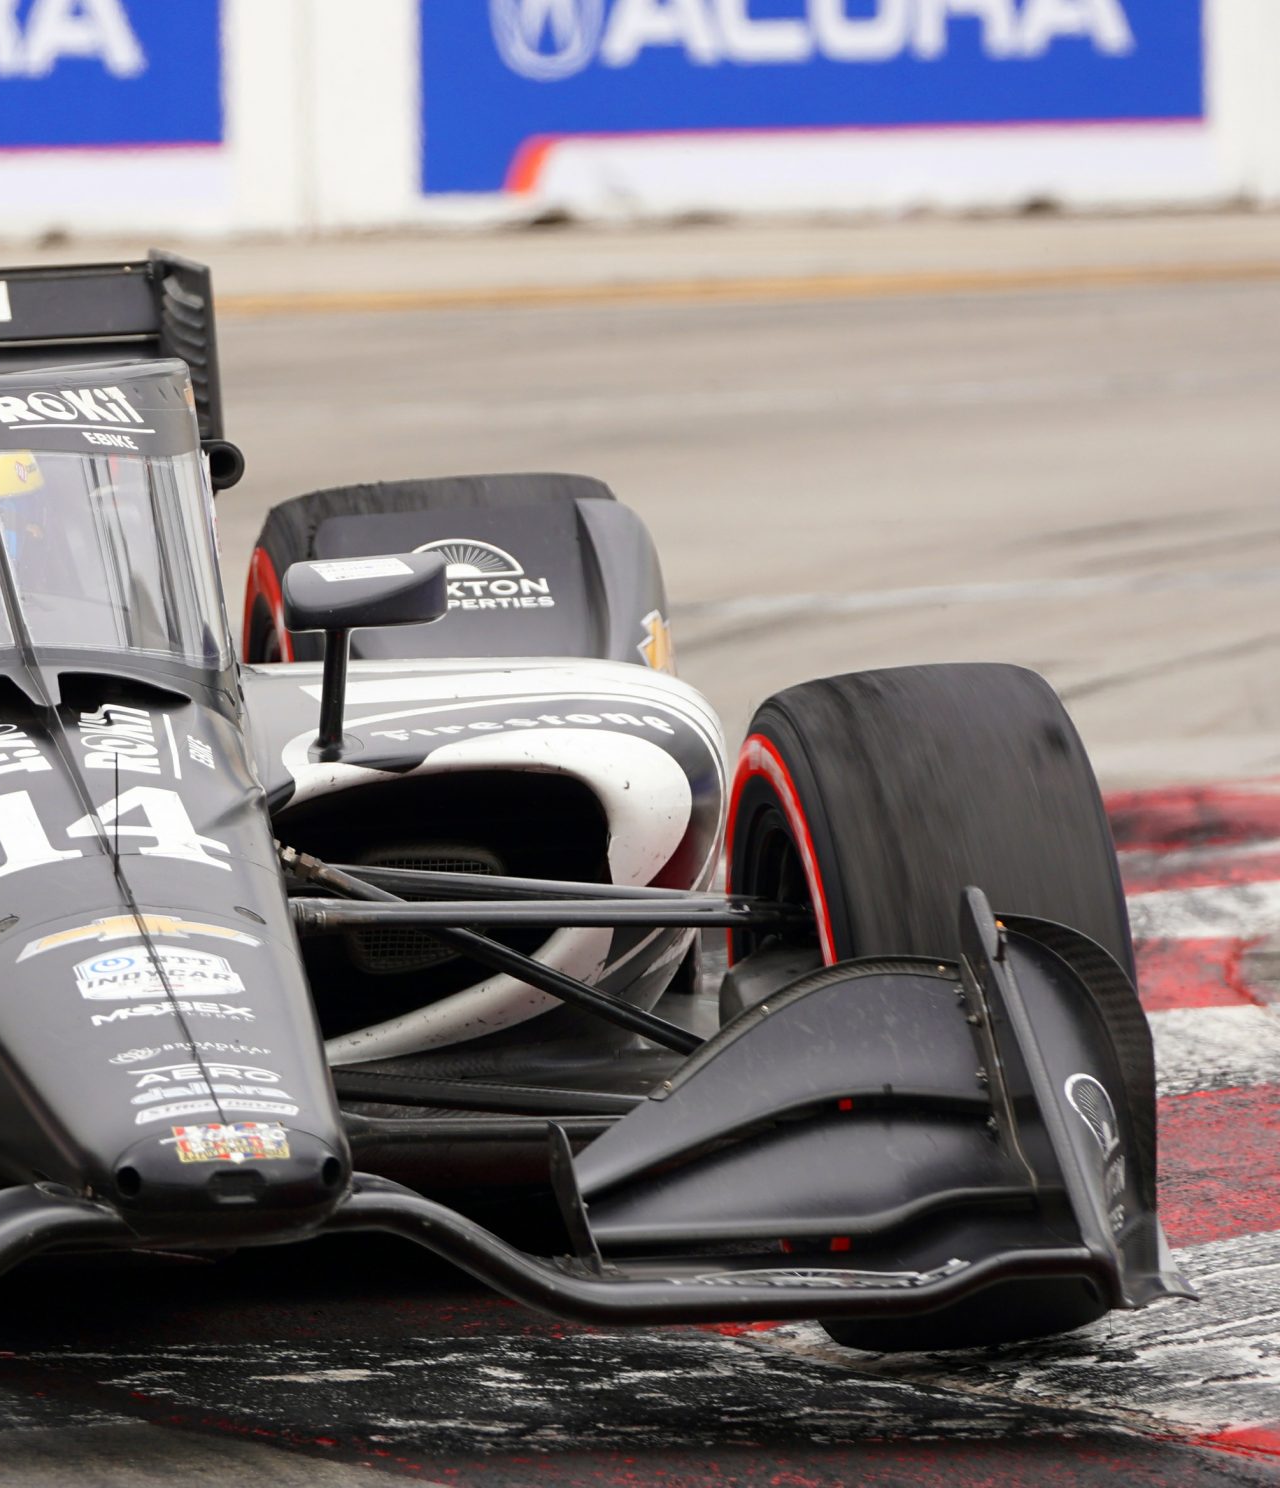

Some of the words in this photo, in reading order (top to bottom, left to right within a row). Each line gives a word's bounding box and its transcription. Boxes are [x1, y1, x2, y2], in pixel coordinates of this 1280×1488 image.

[86, 431, 139, 451] EBIKE
[447, 578, 550, 598] XTON
[447, 596, 554, 610] PERTIES
[370, 713, 675, 742] Firestone
[186, 734, 215, 769] EBIKE
[144, 955, 212, 967] NTT
[87, 969, 232, 989] INDYCAR
[136, 1067, 279, 1088] AERO
